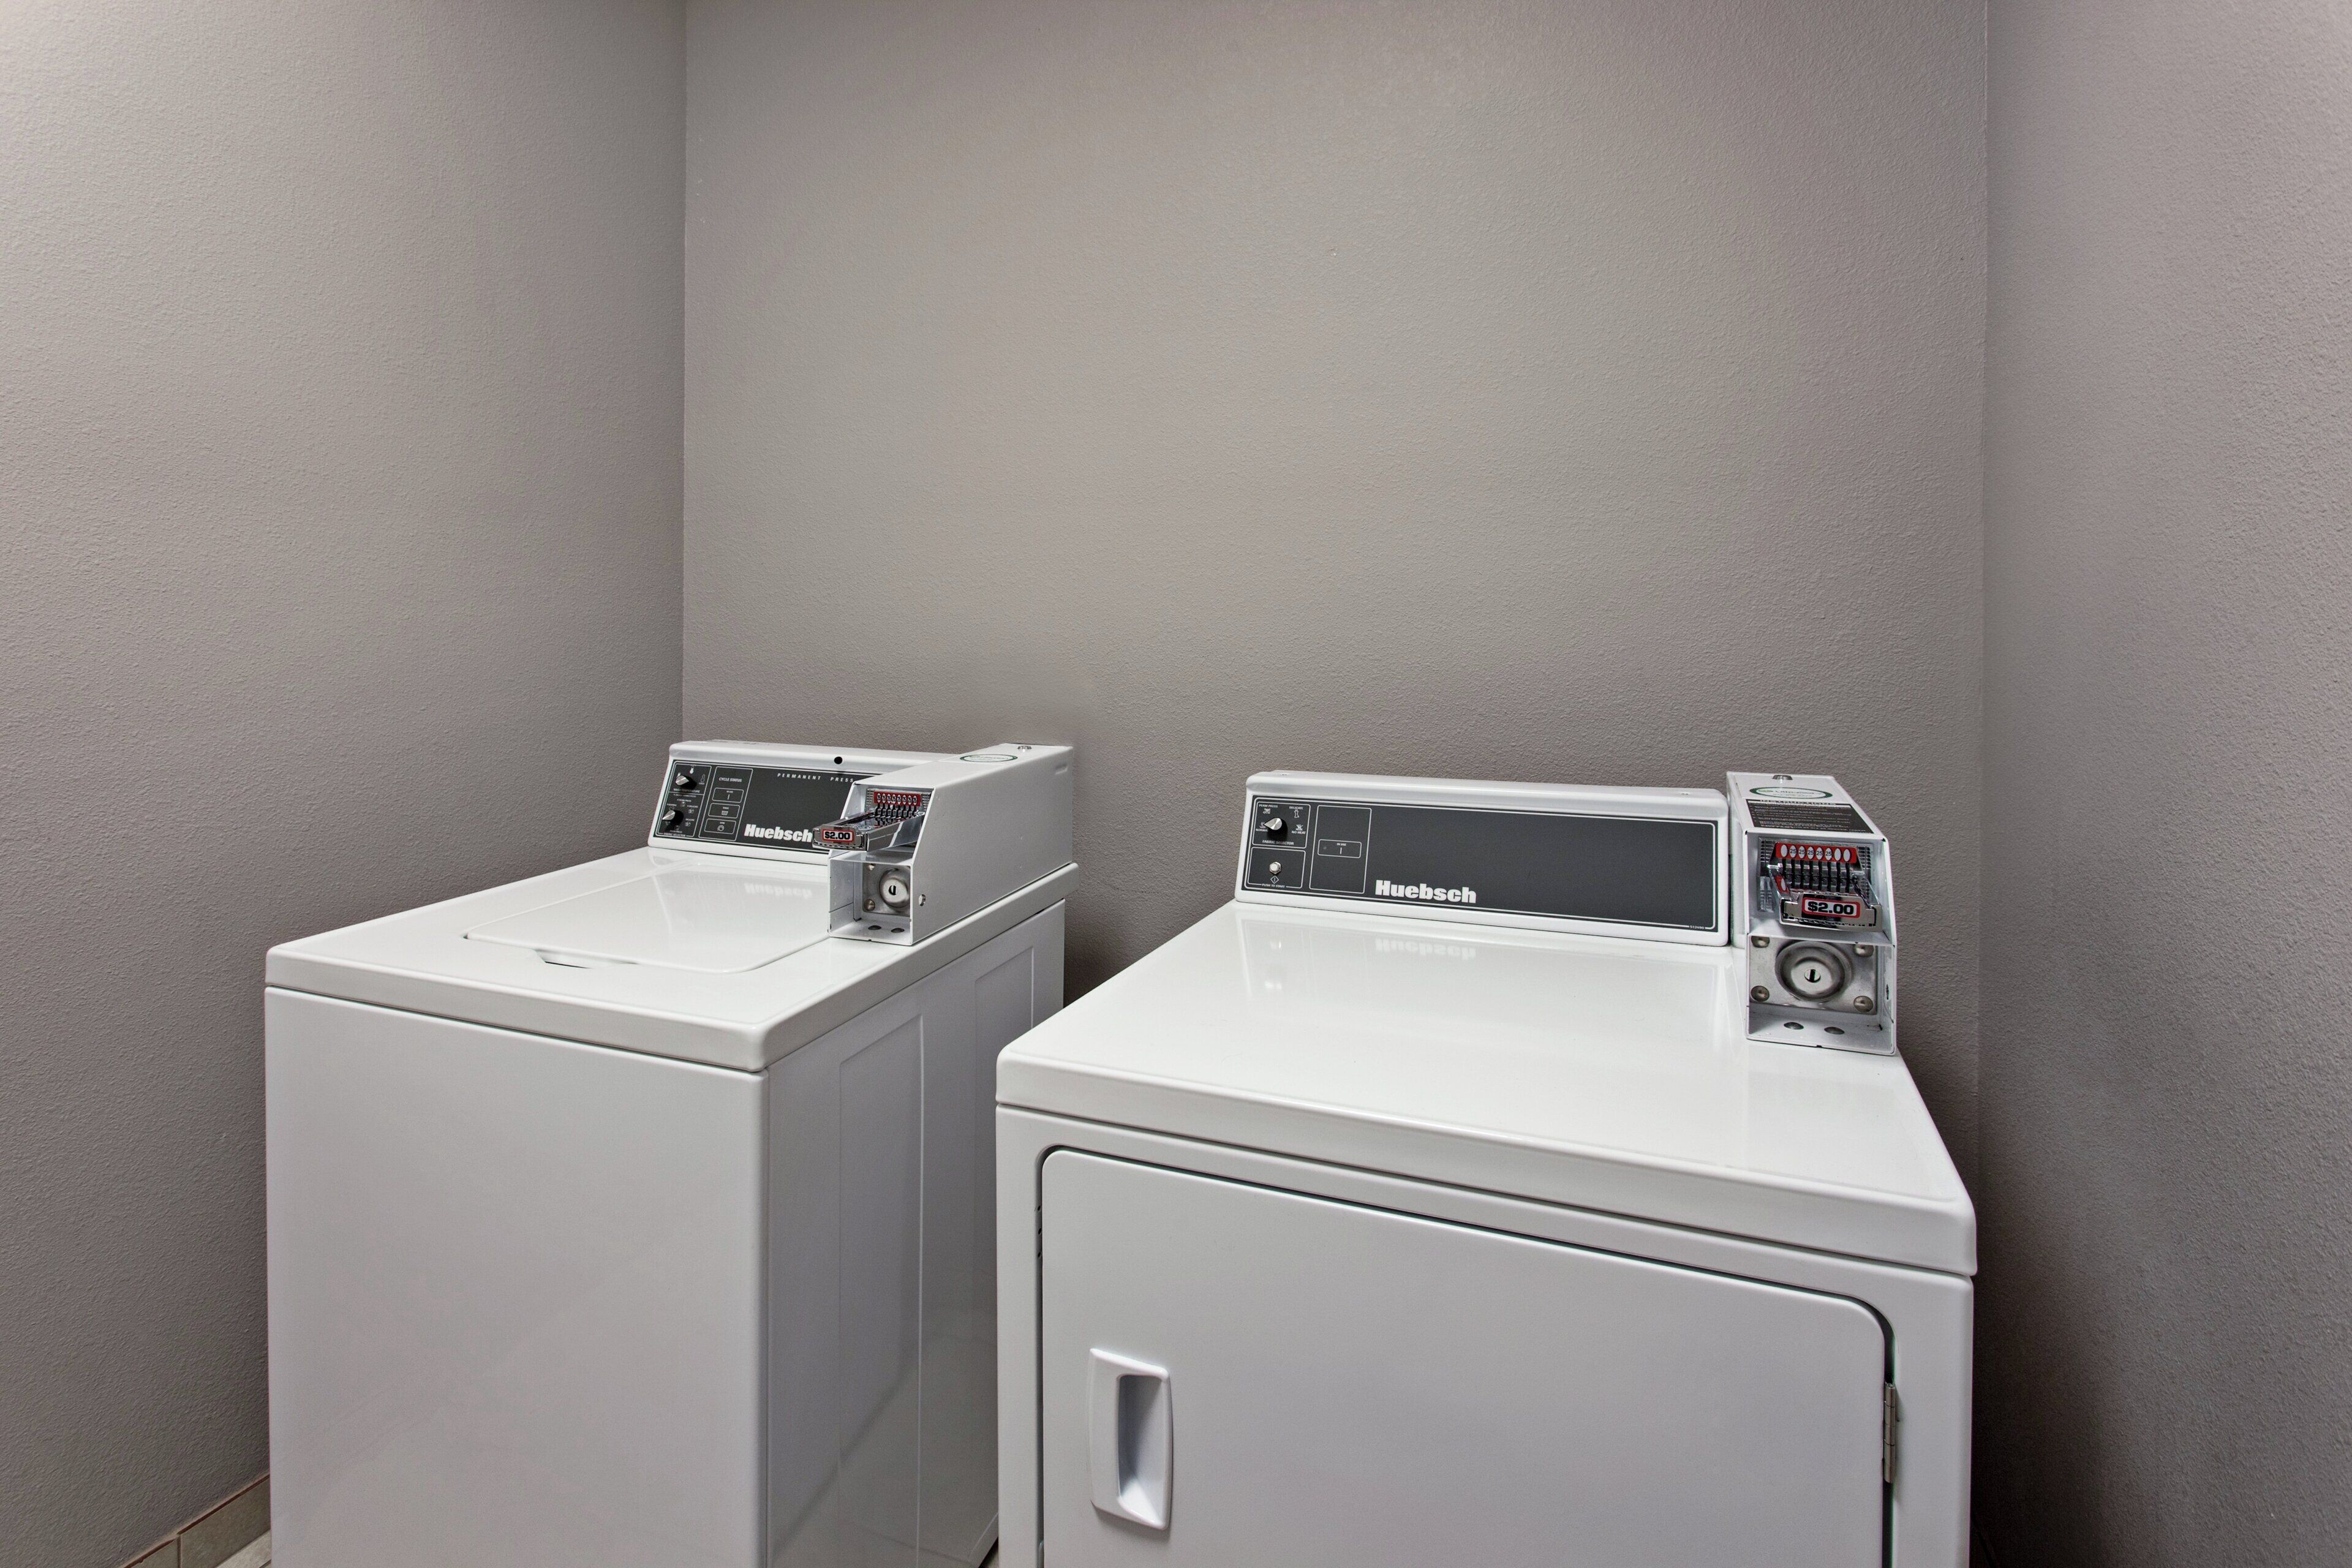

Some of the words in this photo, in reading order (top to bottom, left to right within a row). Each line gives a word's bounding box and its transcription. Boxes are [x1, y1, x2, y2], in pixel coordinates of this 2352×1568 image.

[744, 824, 813, 842] Huebsch
[824, 831, 850, 840] $2.00
[1375, 880, 1476, 903] Huebsch
[1807, 901, 1854, 915] $2.00
